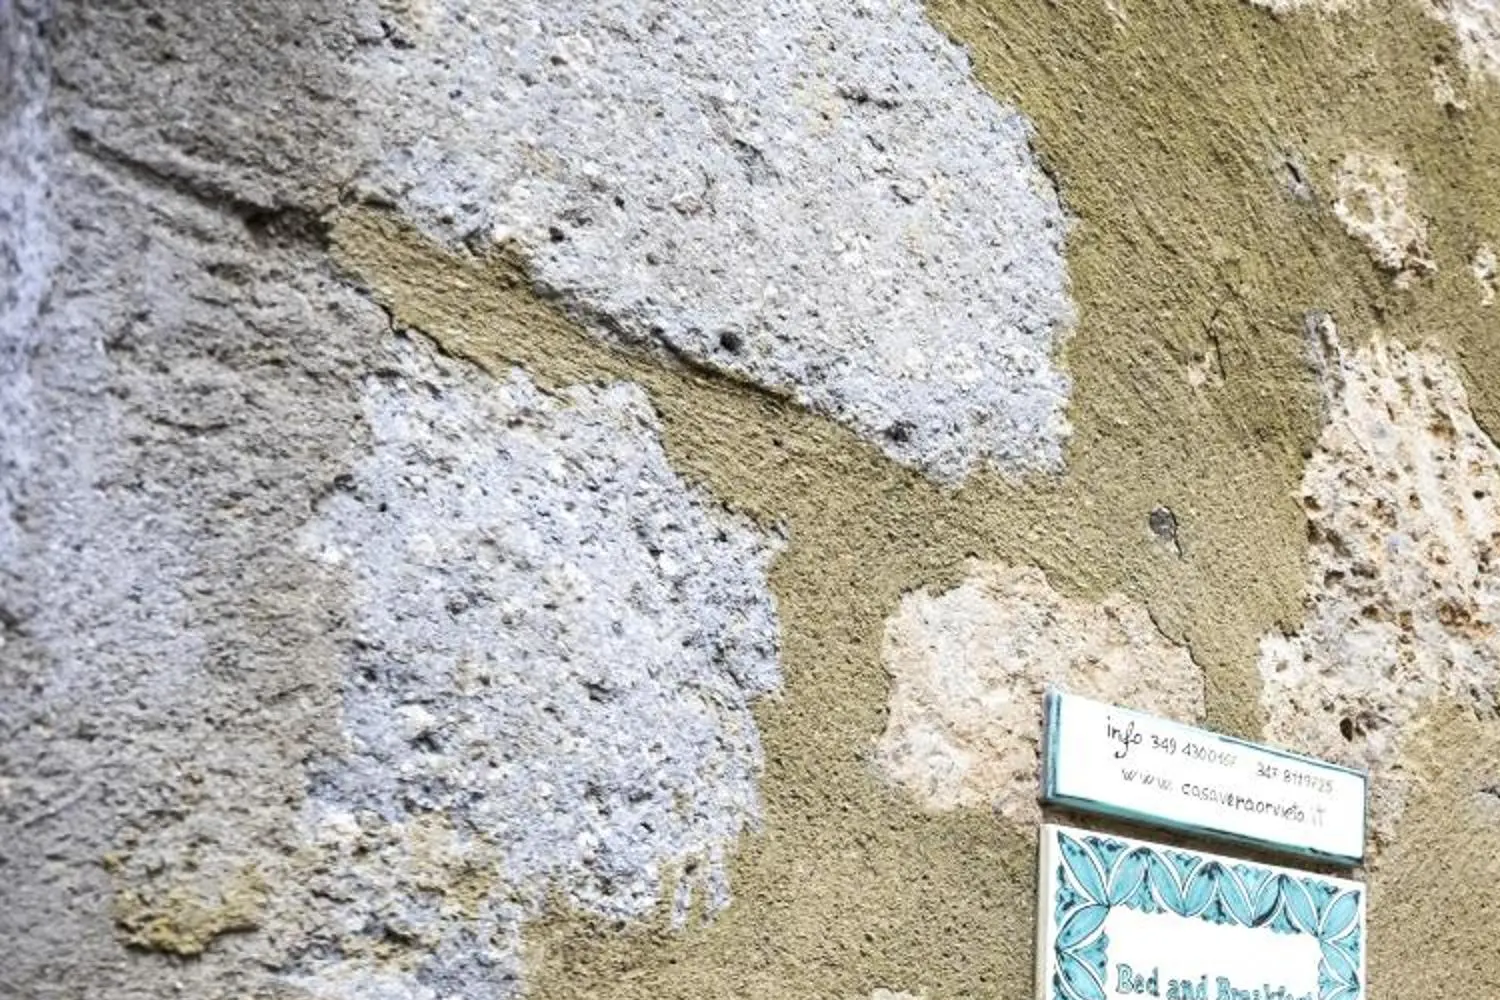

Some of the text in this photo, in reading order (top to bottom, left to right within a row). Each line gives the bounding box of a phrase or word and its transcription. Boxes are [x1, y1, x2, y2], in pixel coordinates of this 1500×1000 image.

[1106, 715, 1143, 759] info
[1150, 734, 1176, 755] 349
[1115, 963, 1160, 997] Bed
